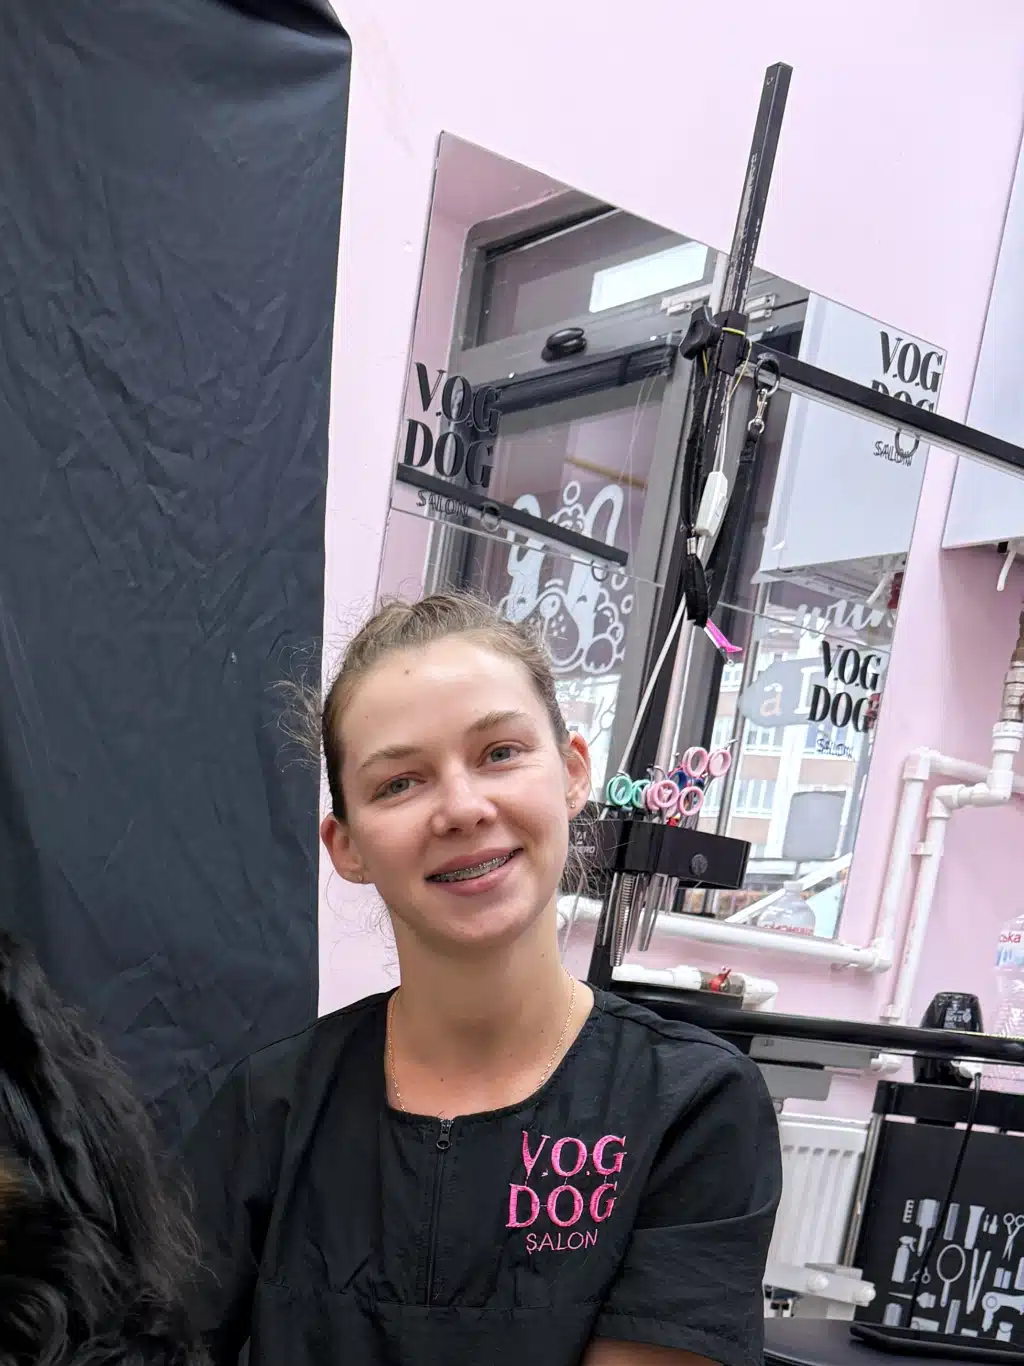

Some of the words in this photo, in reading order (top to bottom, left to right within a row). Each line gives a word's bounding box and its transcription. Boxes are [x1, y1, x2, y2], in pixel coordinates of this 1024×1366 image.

[880, 331, 943, 393] V.O.G
[414, 362, 503, 436] V.O.G
[405, 418, 494, 488] DOG
[821, 640, 883, 691] V.O.G
[808, 684, 876, 733] DOG
[522, 1130, 627, 1179] V.O.G
[505, 1181, 618, 1228] DOG
[526, 1228, 598, 1254] SALON
